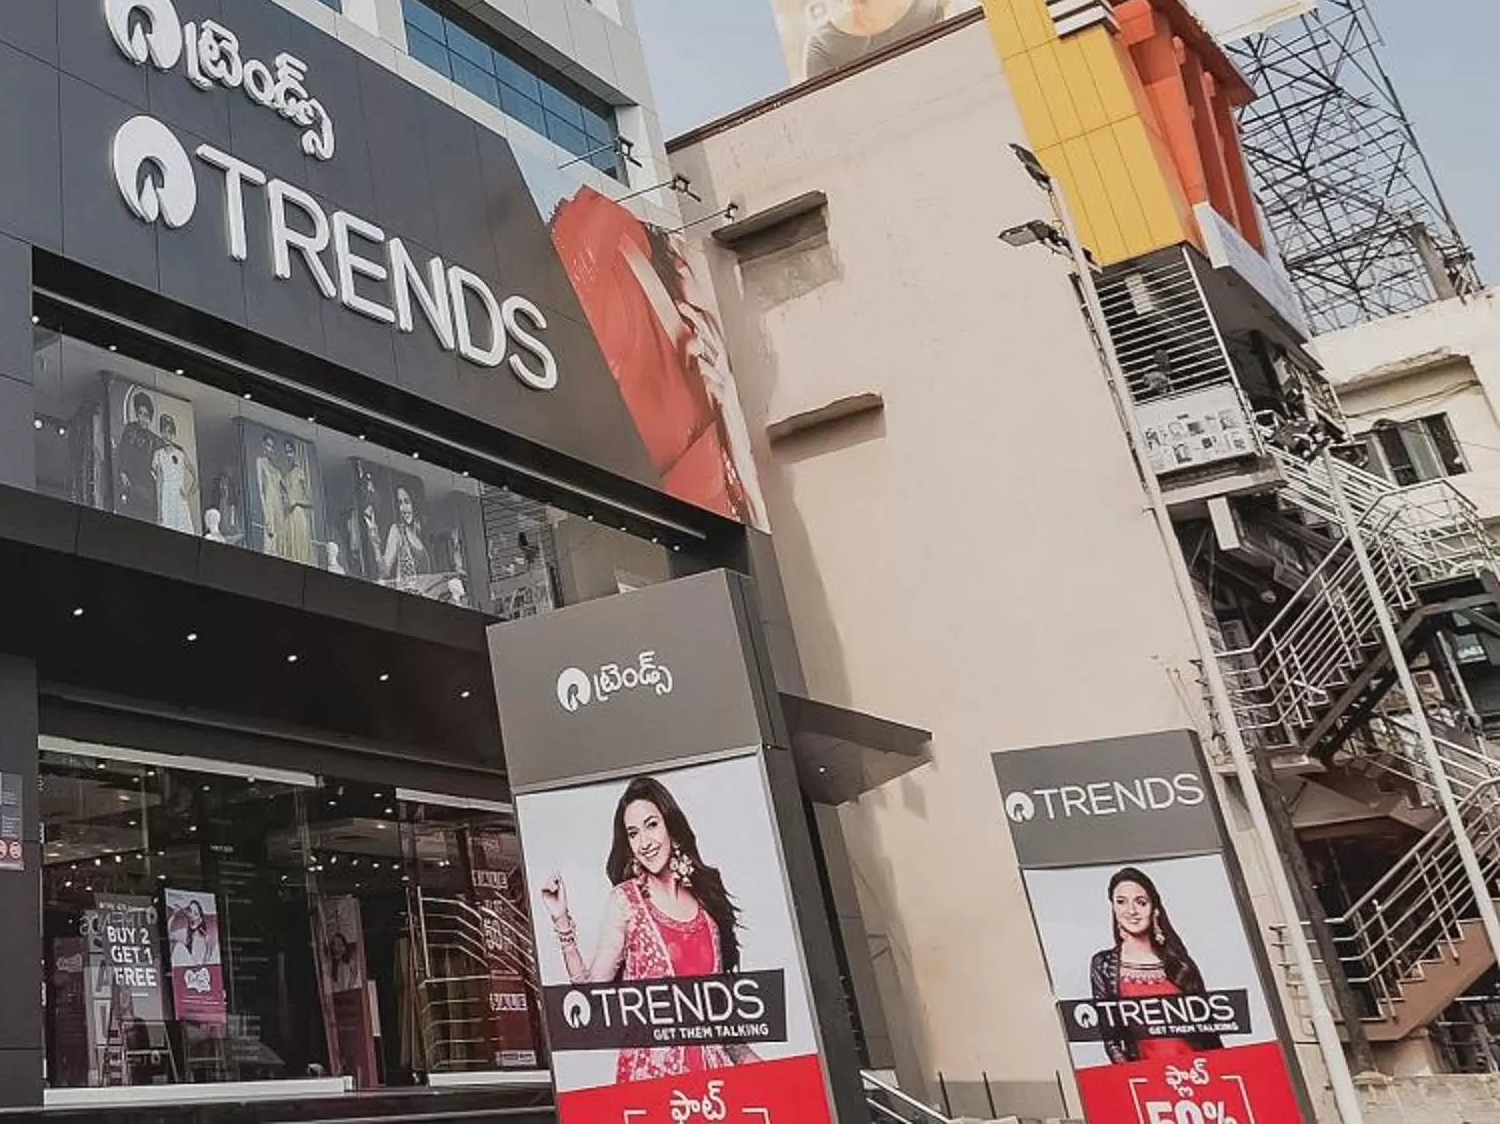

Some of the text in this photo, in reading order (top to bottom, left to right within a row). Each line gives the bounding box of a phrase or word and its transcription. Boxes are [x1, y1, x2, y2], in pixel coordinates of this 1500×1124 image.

[196, 144, 557, 389] TRENDS
[1033, 774, 1205, 820] TRENDS
[106, 925, 151, 945] BUY 2
[110, 945, 153, 965] GET 1
[113, 966, 158, 987] FREE
[591, 978, 766, 1027] TRENDS
[1096, 995, 1235, 1027] TRENDS
[653, 1023, 769, 1041] GET THEM TALKING
[1145, 1100, 1239, 1124] 50%
